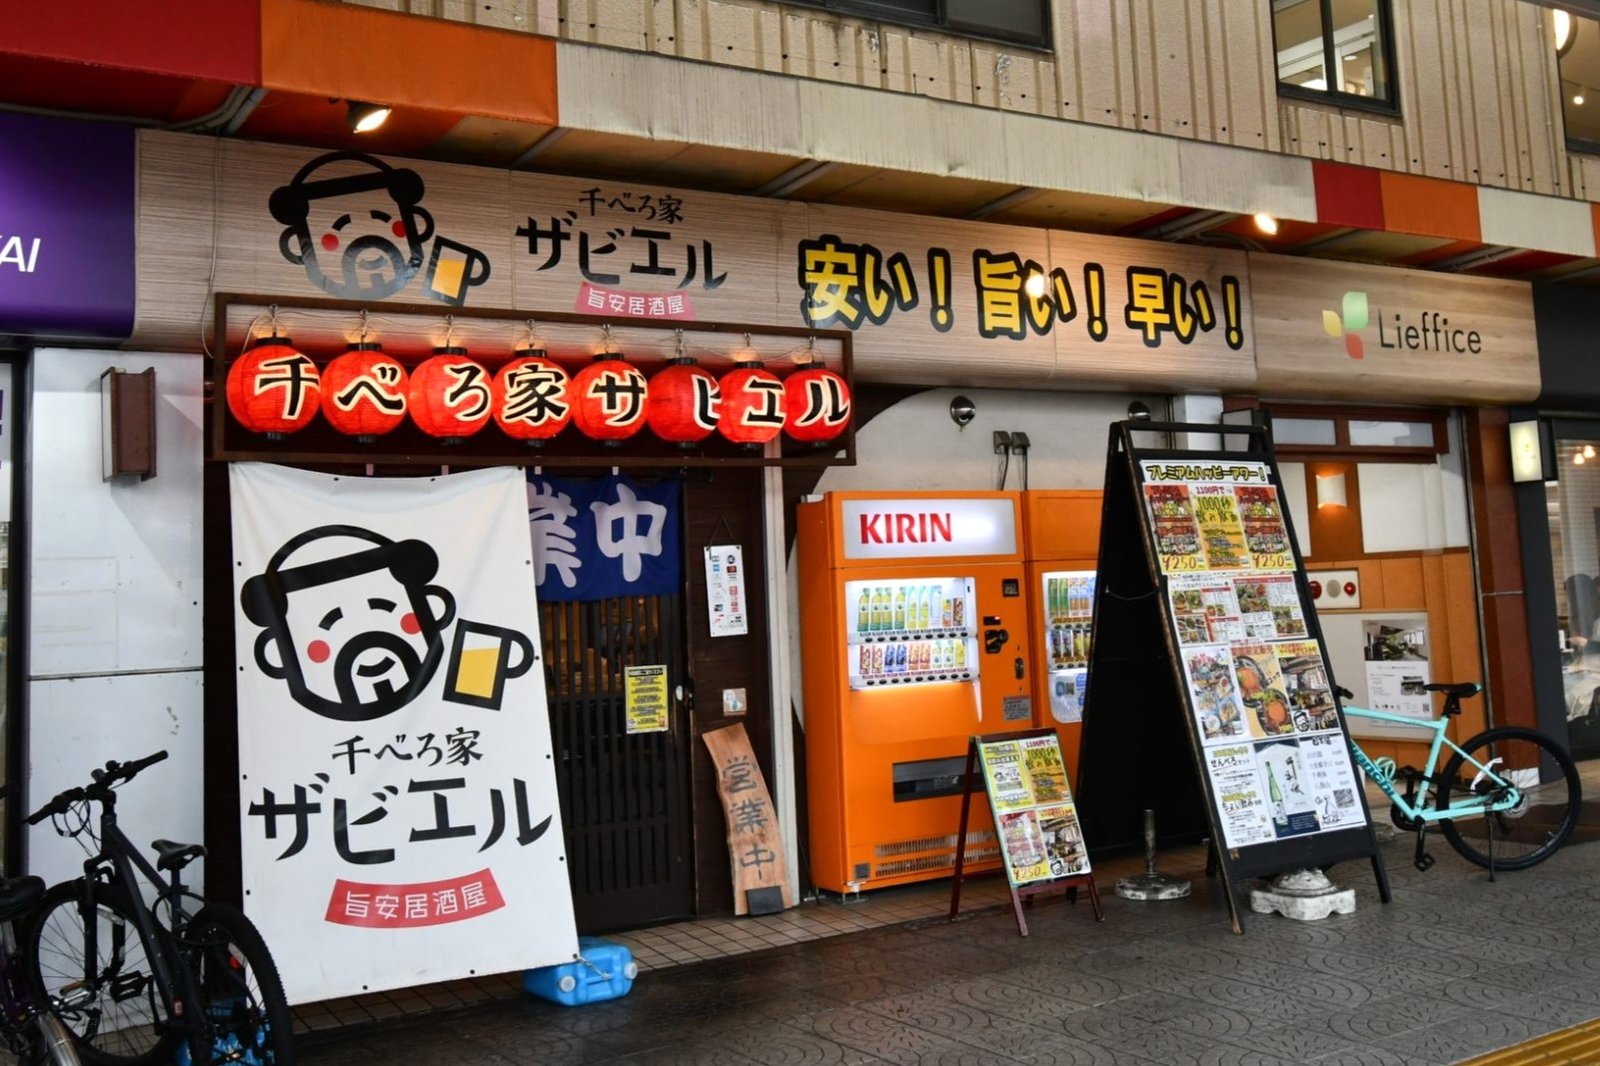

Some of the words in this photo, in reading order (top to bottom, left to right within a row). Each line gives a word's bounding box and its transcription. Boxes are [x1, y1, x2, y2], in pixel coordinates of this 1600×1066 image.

[579, 187, 684, 224] 千べろ家
[0, 235, 42, 273] AI
[515, 210, 728, 291] ザビエル
[587, 287, 685, 316] 旨安居酒屋
[1377, 306, 1483, 355] Lieffice
[859, 512, 953, 545] KIRIN
[332, 727, 483, 775] 千べろ家
[247, 772, 553, 865] ザビエル
[344, 881, 488, 920] 旨安居酒屋
